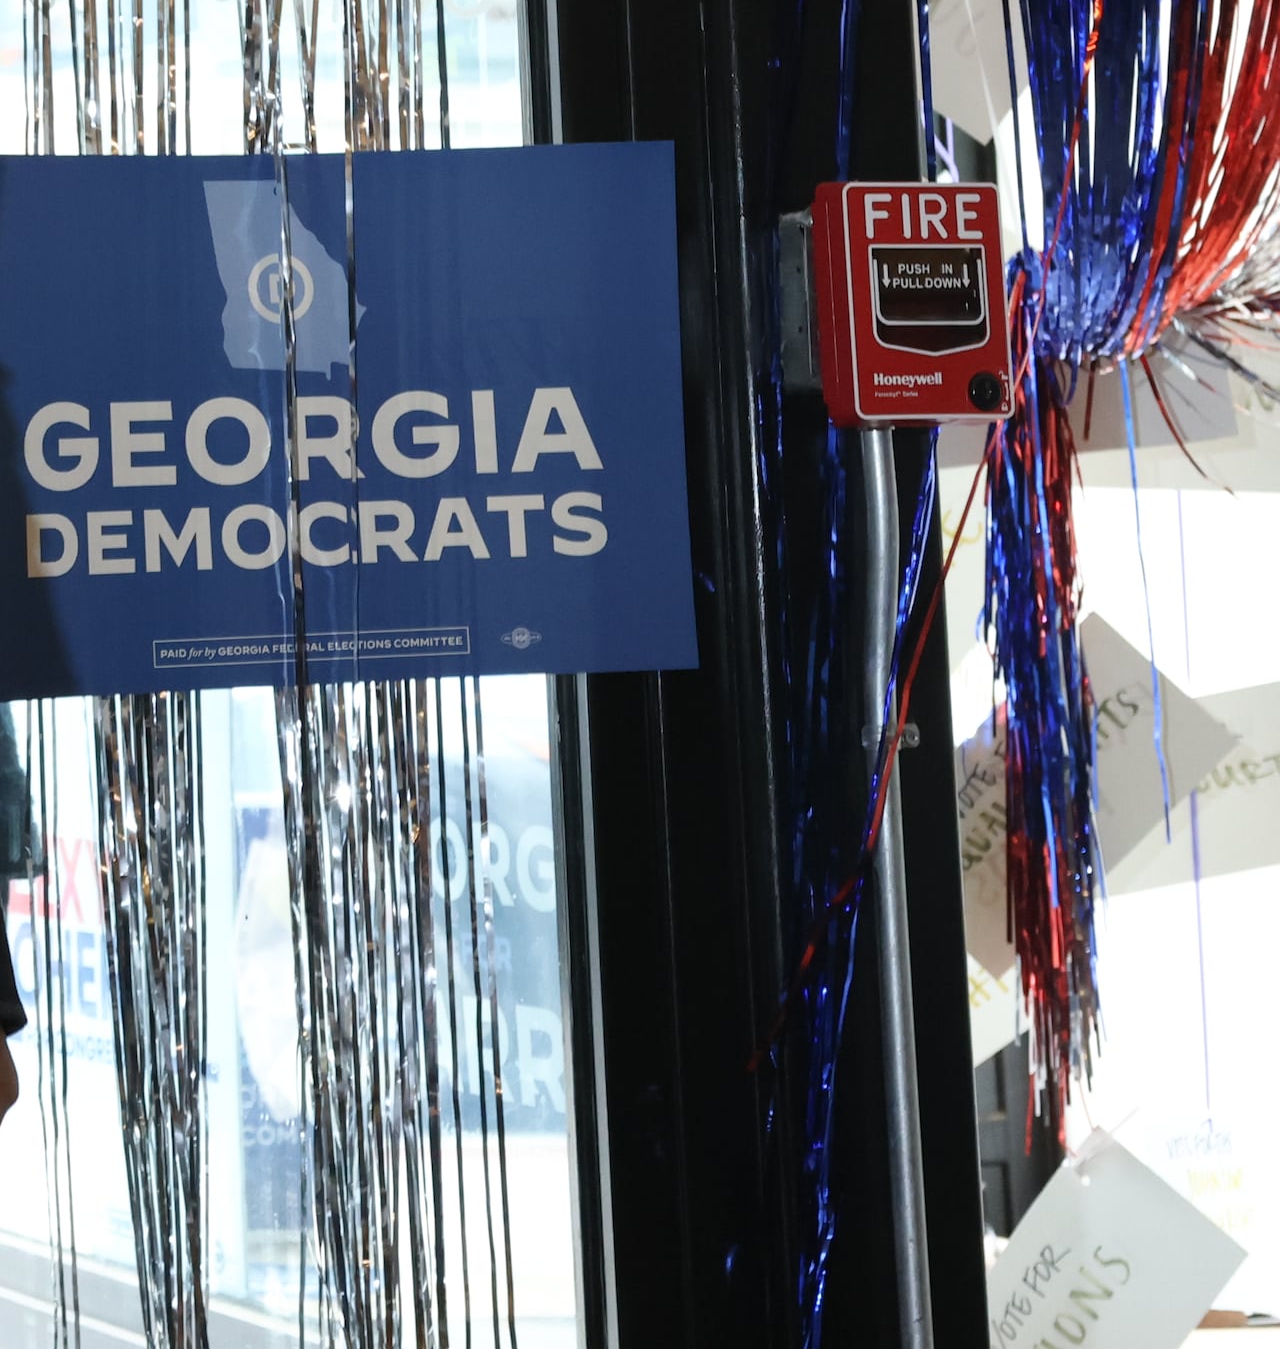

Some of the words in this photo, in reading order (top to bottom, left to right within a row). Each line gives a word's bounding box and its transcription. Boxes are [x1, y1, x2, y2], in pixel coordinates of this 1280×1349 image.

[863, 193, 983, 239] FIRE
[897, 263, 930, 275] PUSH
[941, 263, 953, 274] IN
[873, 372, 942, 388] Honeywell
[23, 385, 604, 492] GEORGIA
[26, 492, 609, 578] DEMOCRATS
[160, 649, 187, 658] PAID
[187, 648, 203, 660] for
[204, 647, 216, 660] by
[218, 645, 270, 656] GEORGIA
[272, 643, 325, 654] FEDRAL
[327, 639, 391, 651] ELECTIONS
[393, 636, 463, 648] COMMITTEE
[1022, 1244, 1072, 1299] FOR
